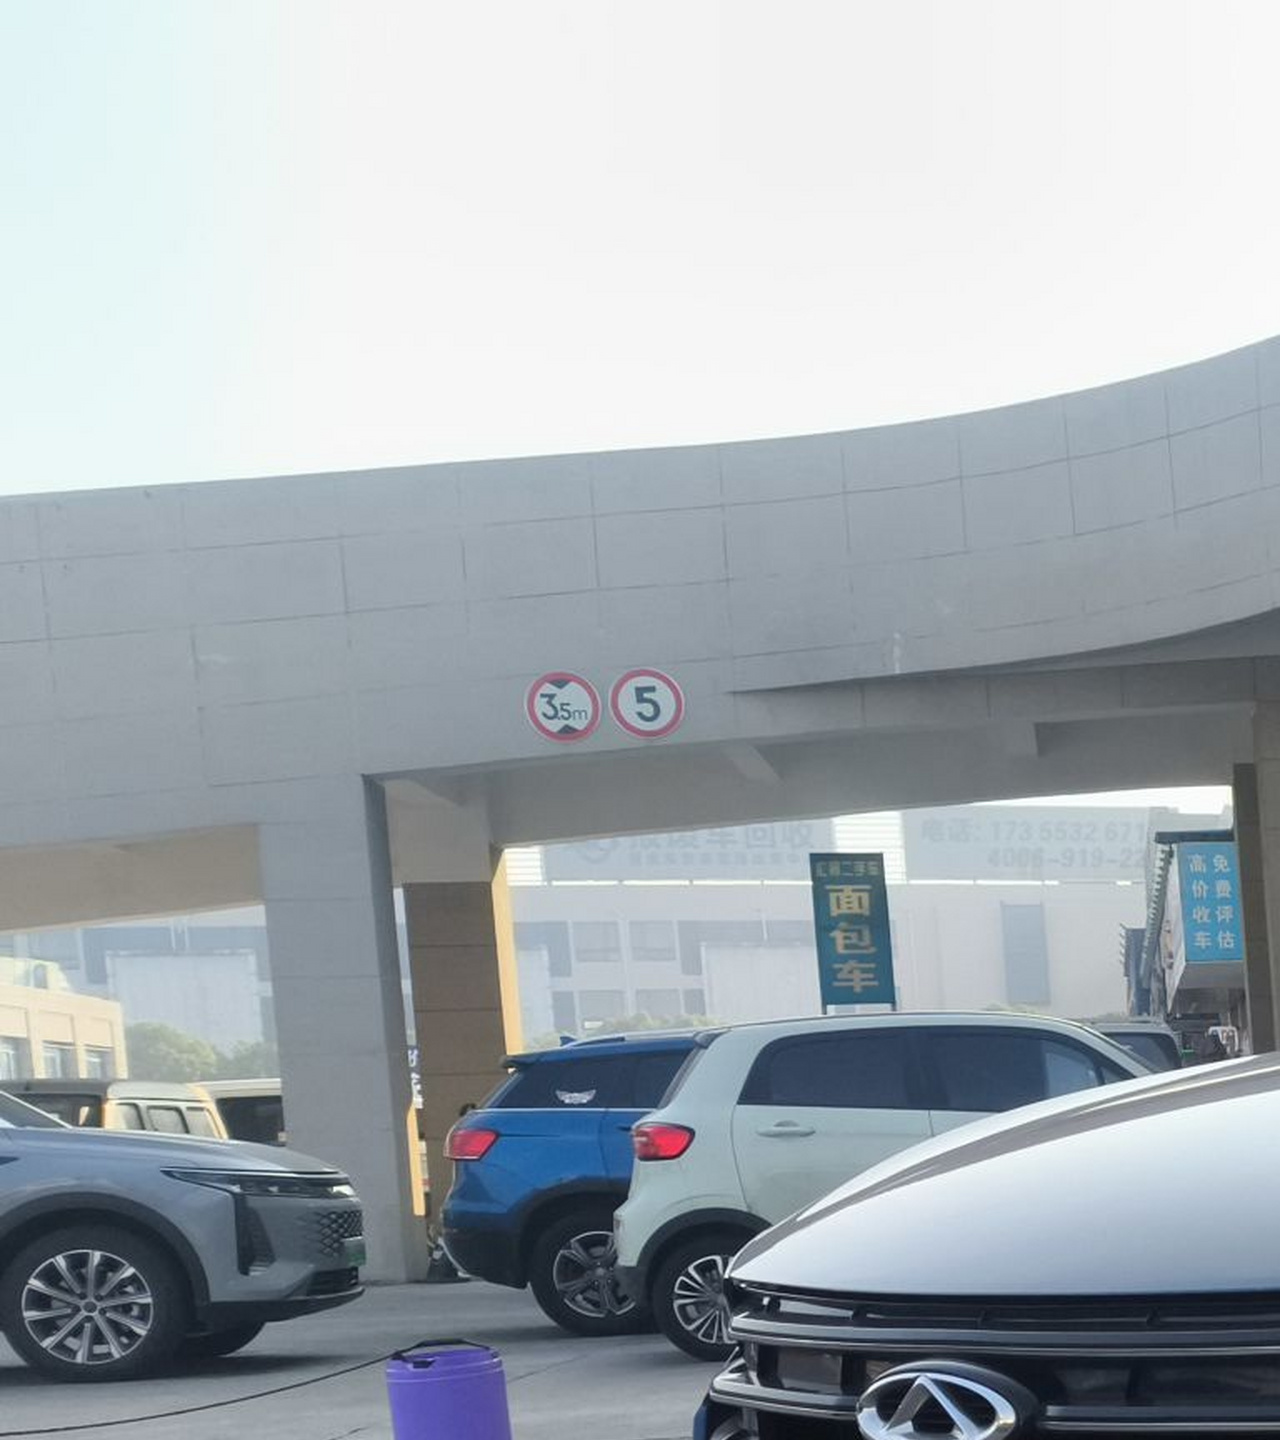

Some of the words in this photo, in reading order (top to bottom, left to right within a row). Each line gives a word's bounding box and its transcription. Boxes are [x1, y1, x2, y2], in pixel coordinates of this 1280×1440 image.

[539, 692, 589, 721] 3.5m
[634, 685, 661, 722] 5
[824, 884, 880, 993] 面包车
